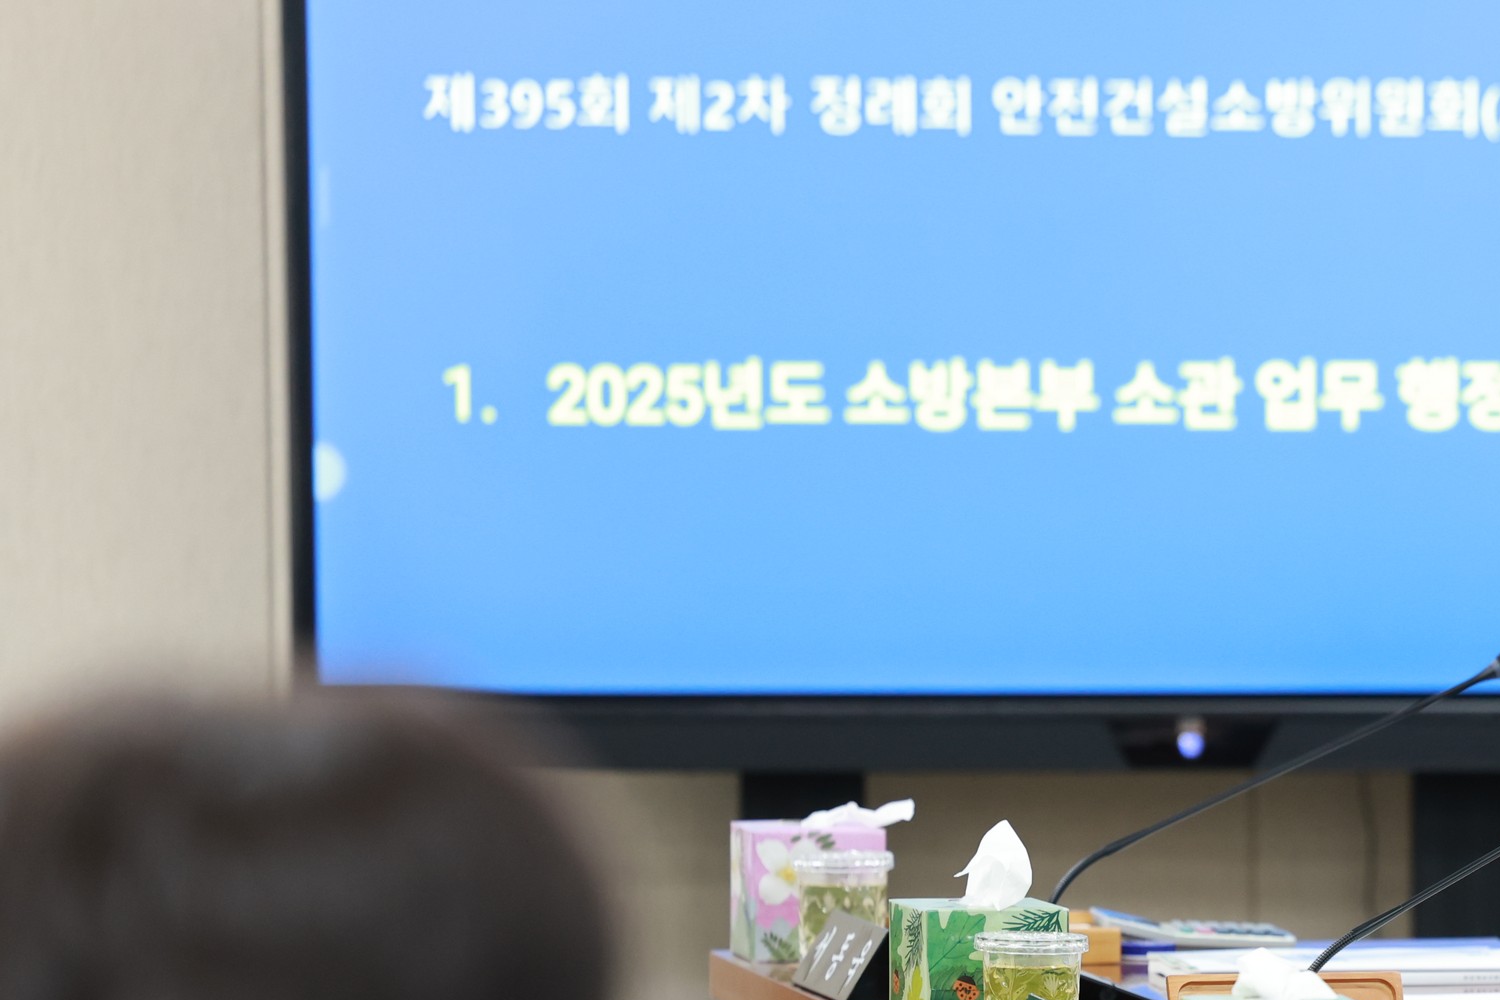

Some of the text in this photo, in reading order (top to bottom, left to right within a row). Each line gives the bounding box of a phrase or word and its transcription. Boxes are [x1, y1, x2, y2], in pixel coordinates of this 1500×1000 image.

[424, 73, 630, 134] 제395회
[649, 74, 791, 135] 제2차
[811, 75, 972, 136] 정례회
[443, 364, 498, 424] 1.
[547, 357, 831, 431] 2025년도
[845, 356, 1100, 433] 소방본부
[1112, 357, 1243, 431] 소관
[1255, 357, 1385, 432] 업무
